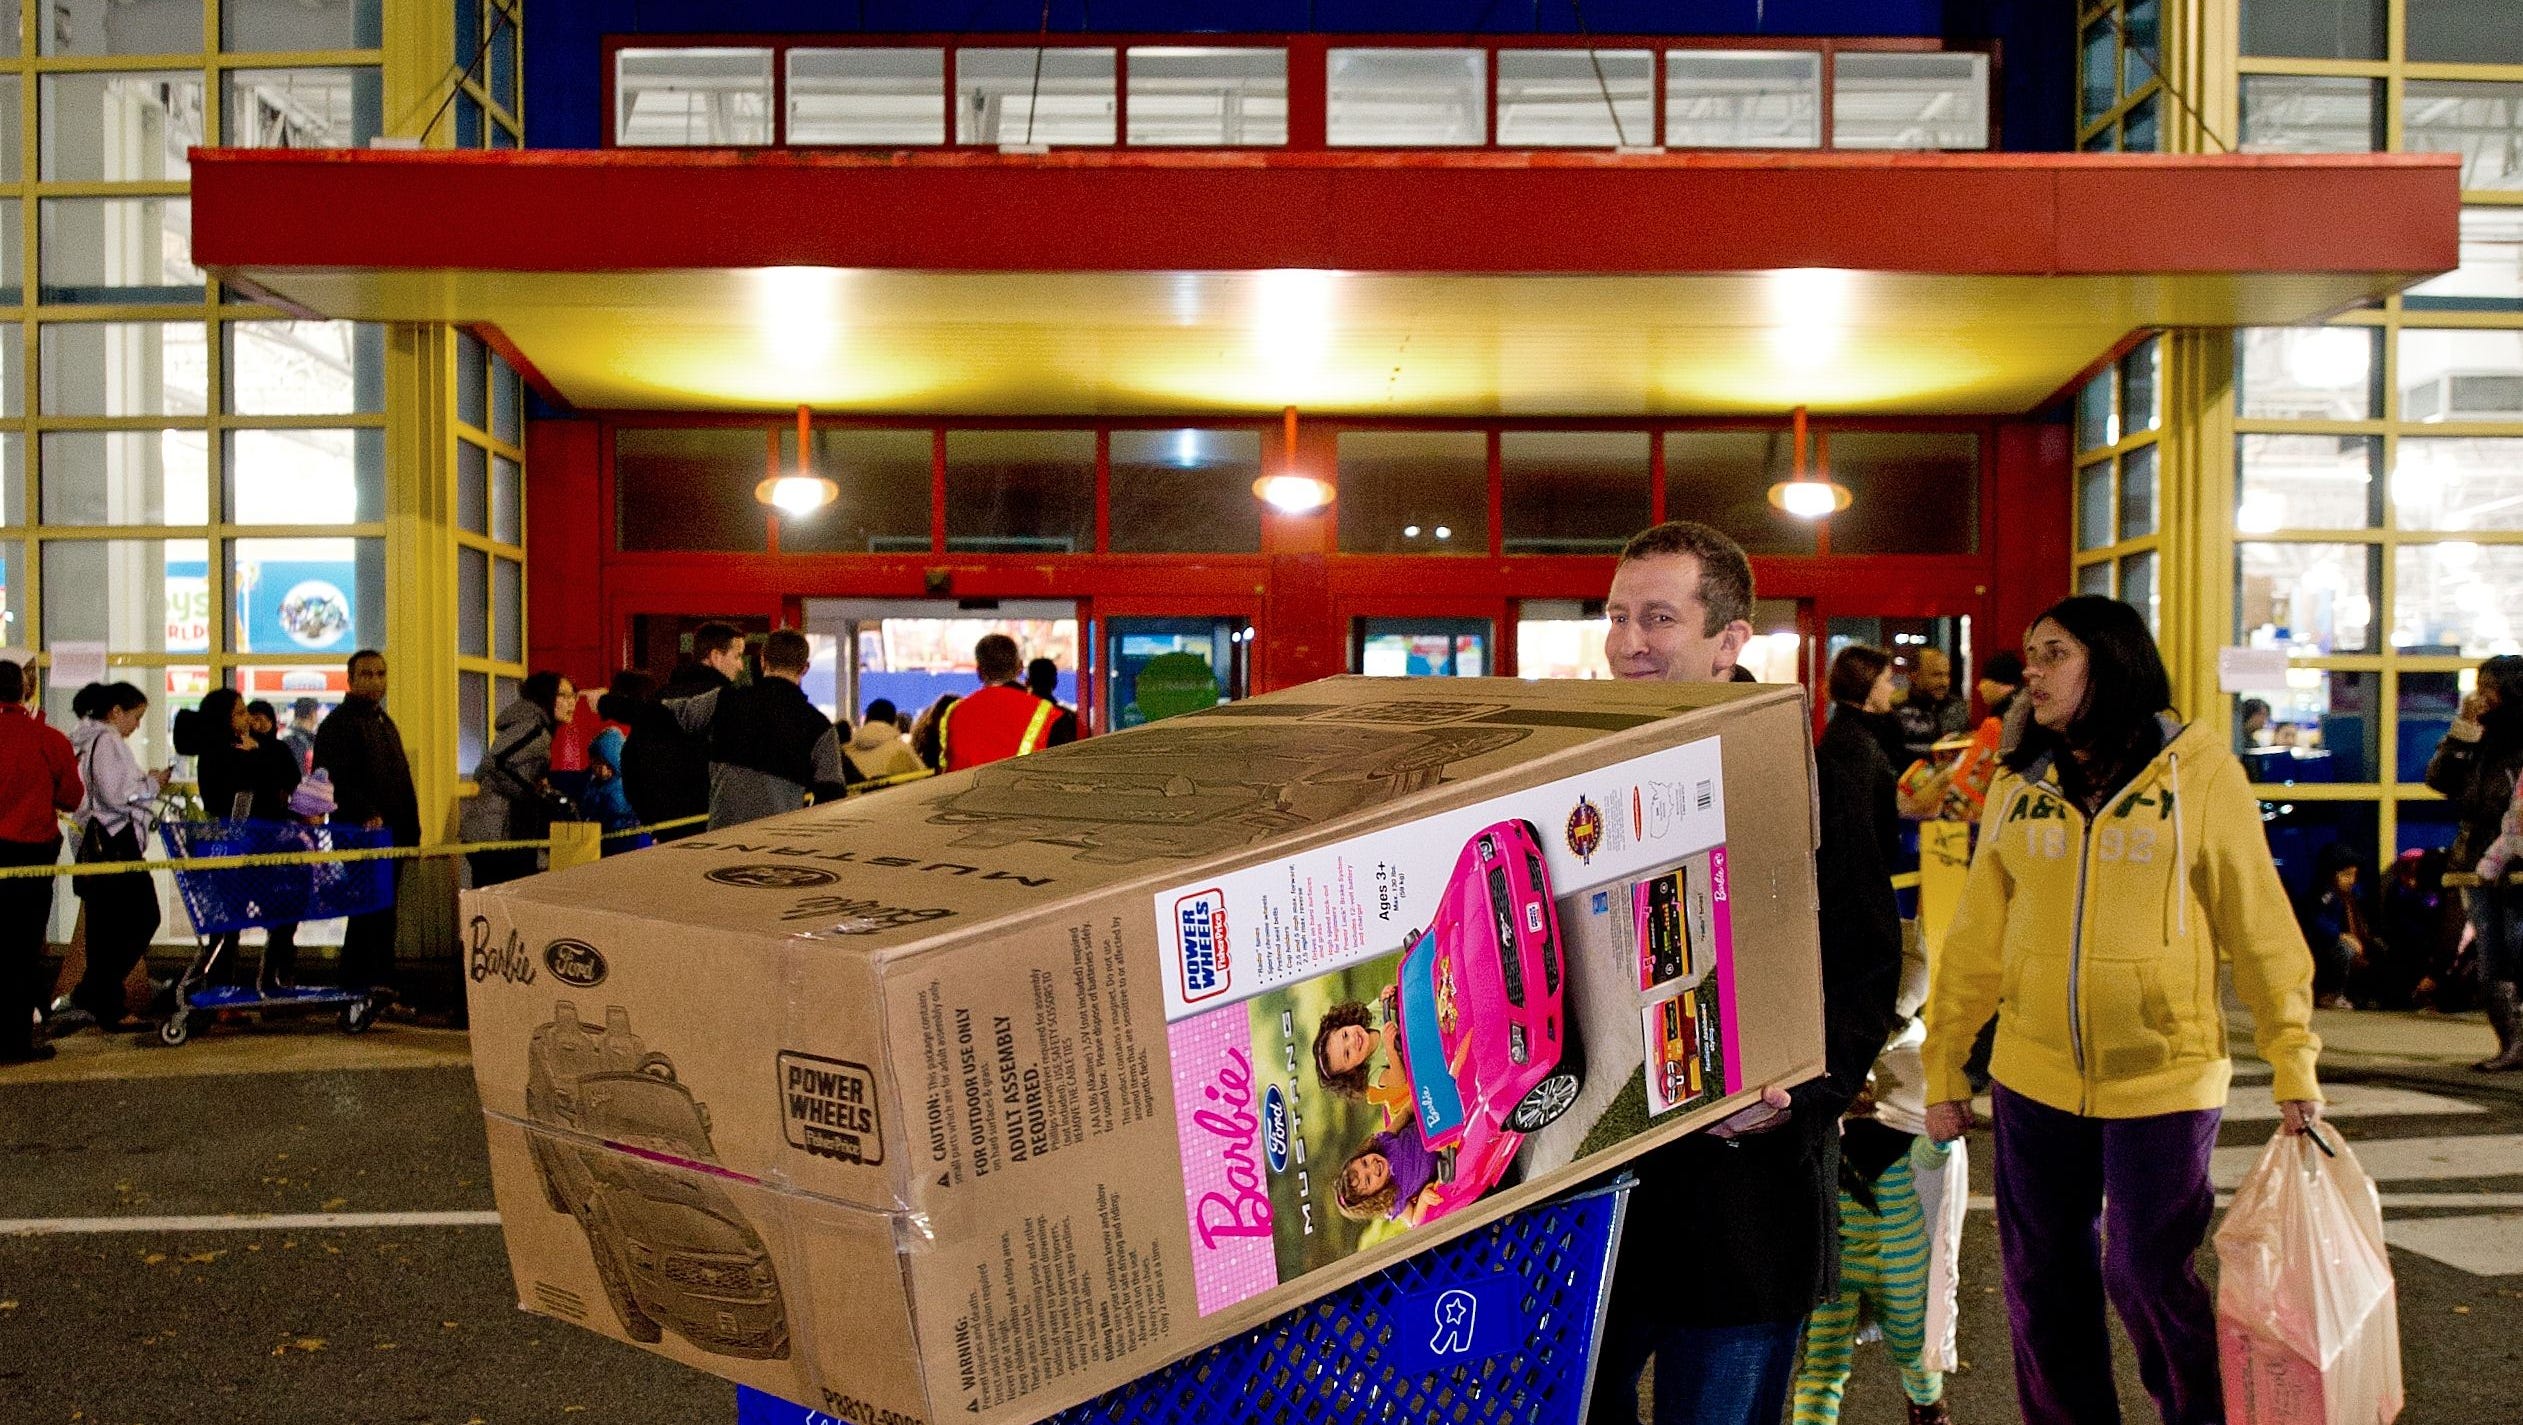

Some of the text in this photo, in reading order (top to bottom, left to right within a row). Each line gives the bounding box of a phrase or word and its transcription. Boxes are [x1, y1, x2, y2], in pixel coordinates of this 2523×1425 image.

[1376, 861, 1390, 920] Ages 3+
[1713, 865, 1726, 903] Barbie
[471, 915, 536, 985] Barbie
[1183, 909, 1200, 990] POWER
[1196, 900, 1214, 987] WHEELS
[1042, 971, 1051, 983] TO
[1085, 951, 1096, 991] batteries
[1043, 984, 1056, 1026] SCISSORS
[924, 1031, 936, 1069] package
[1037, 1025, 1050, 1063] required
[1049, 1028, 1060, 1061] SAFETY
[789, 1065, 863, 1104] POWER
[956, 1007, 988, 1176] FOR OUTDOOR USE ONLY
[994, 1014, 1026, 1163] ADULT ASSEMBLY
[1053, 1063, 1062, 1080] USE
[1062, 1037, 1082, 1142] REMOVE THE CABLE TIES
[789, 1093, 872, 1133] WHEELS
[985, 1098, 996, 1134] surfaces
[1023, 1063, 1047, 1156] REQUIRED.
[1141, 1076, 1153, 1116] magnetic
[1424, 1084, 1440, 1129] Barbie
[927, 1093, 945, 1160] CAUTION:
[1281, 1011, 1313, 1236] MUSTANG
[949, 1134, 961, 1158] parts
[988, 1137, 998, 1158] hard
[1195, 1047, 1273, 1250] Barbie
[956, 1316, 974, 1389] WARNING:
[1100, 1301, 1113, 1361] Riding Rules
